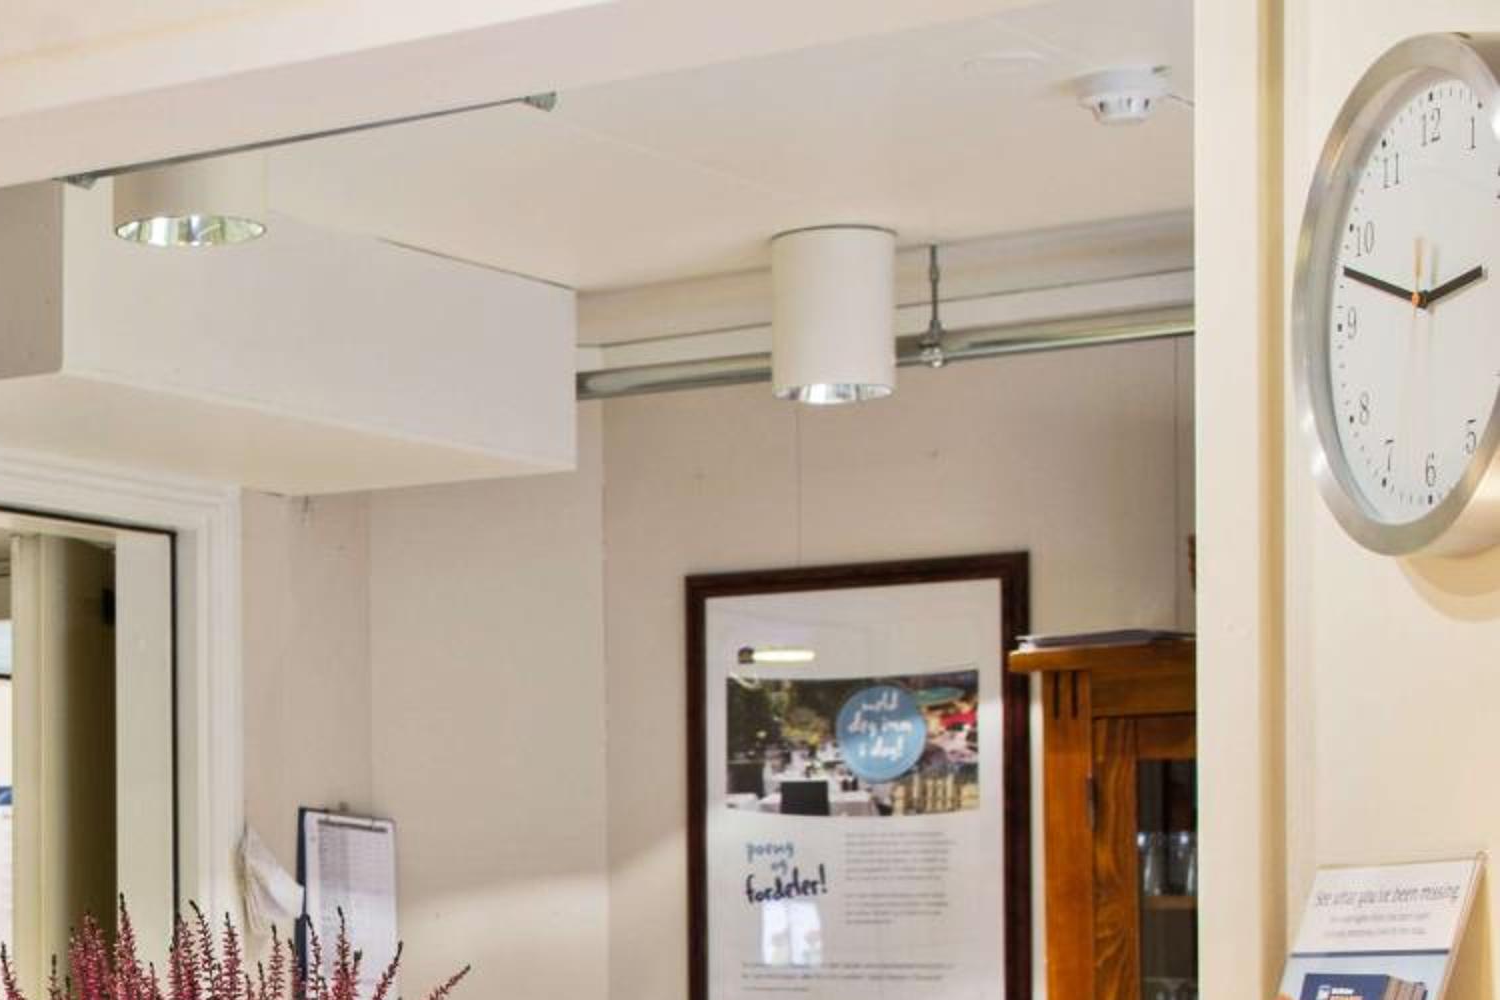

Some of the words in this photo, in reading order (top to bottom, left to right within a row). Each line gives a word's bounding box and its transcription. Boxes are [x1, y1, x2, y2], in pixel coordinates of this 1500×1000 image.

[1421, 107, 1441, 146] 12
[1467, 116, 1476, 150] 1
[1382, 152, 1400, 189] 11
[1356, 220, 1375, 257] 10
[1347, 306, 1357, 339] 9
[1360, 392, 1370, 426] 8
[1465, 419, 1477, 455] 5
[1384, 438, 1395, 473] 7
[1425, 451, 1437, 487] 6
